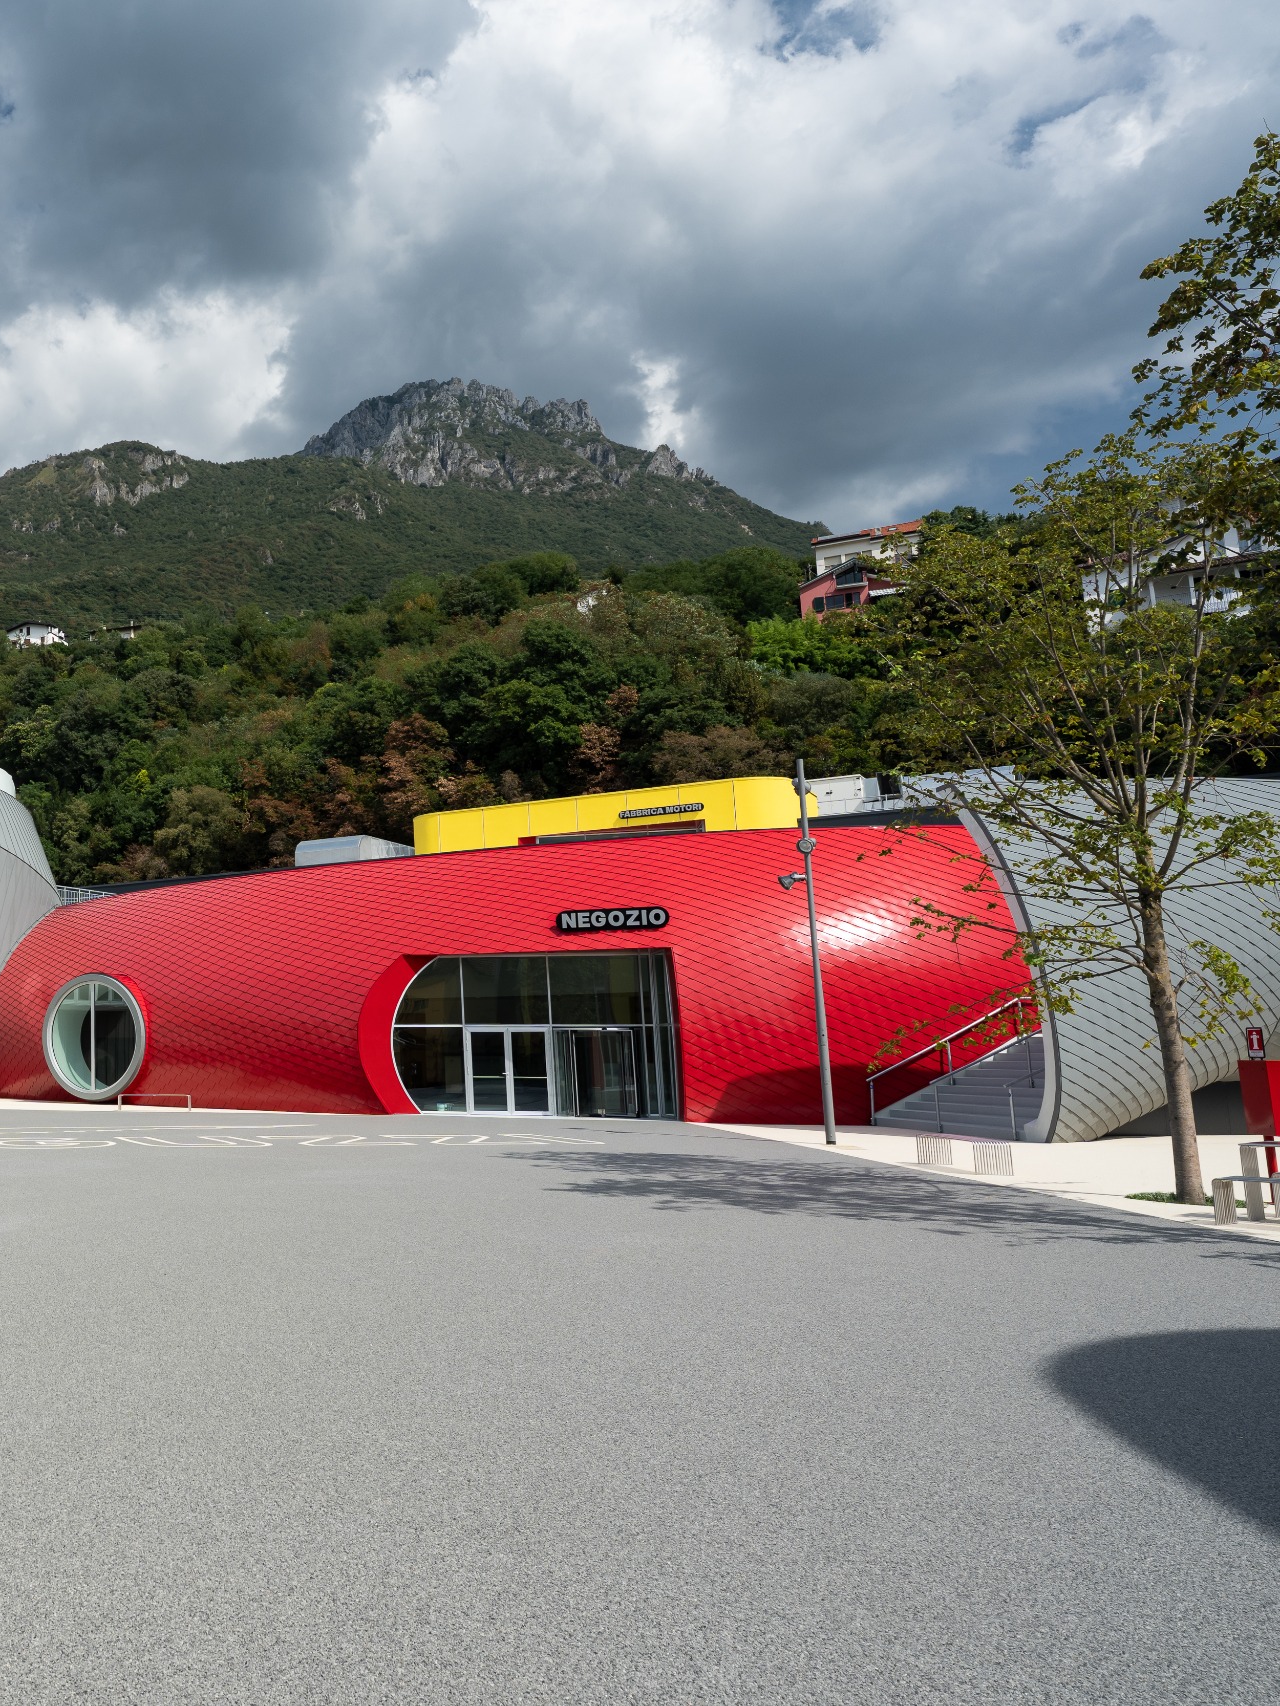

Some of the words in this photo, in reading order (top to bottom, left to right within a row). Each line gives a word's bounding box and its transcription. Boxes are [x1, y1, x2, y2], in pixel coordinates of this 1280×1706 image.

[619, 807, 664, 818] FABBRICA
[665, 803, 702, 814] MOTORI
[561, 908, 666, 929] NEGOZIO
